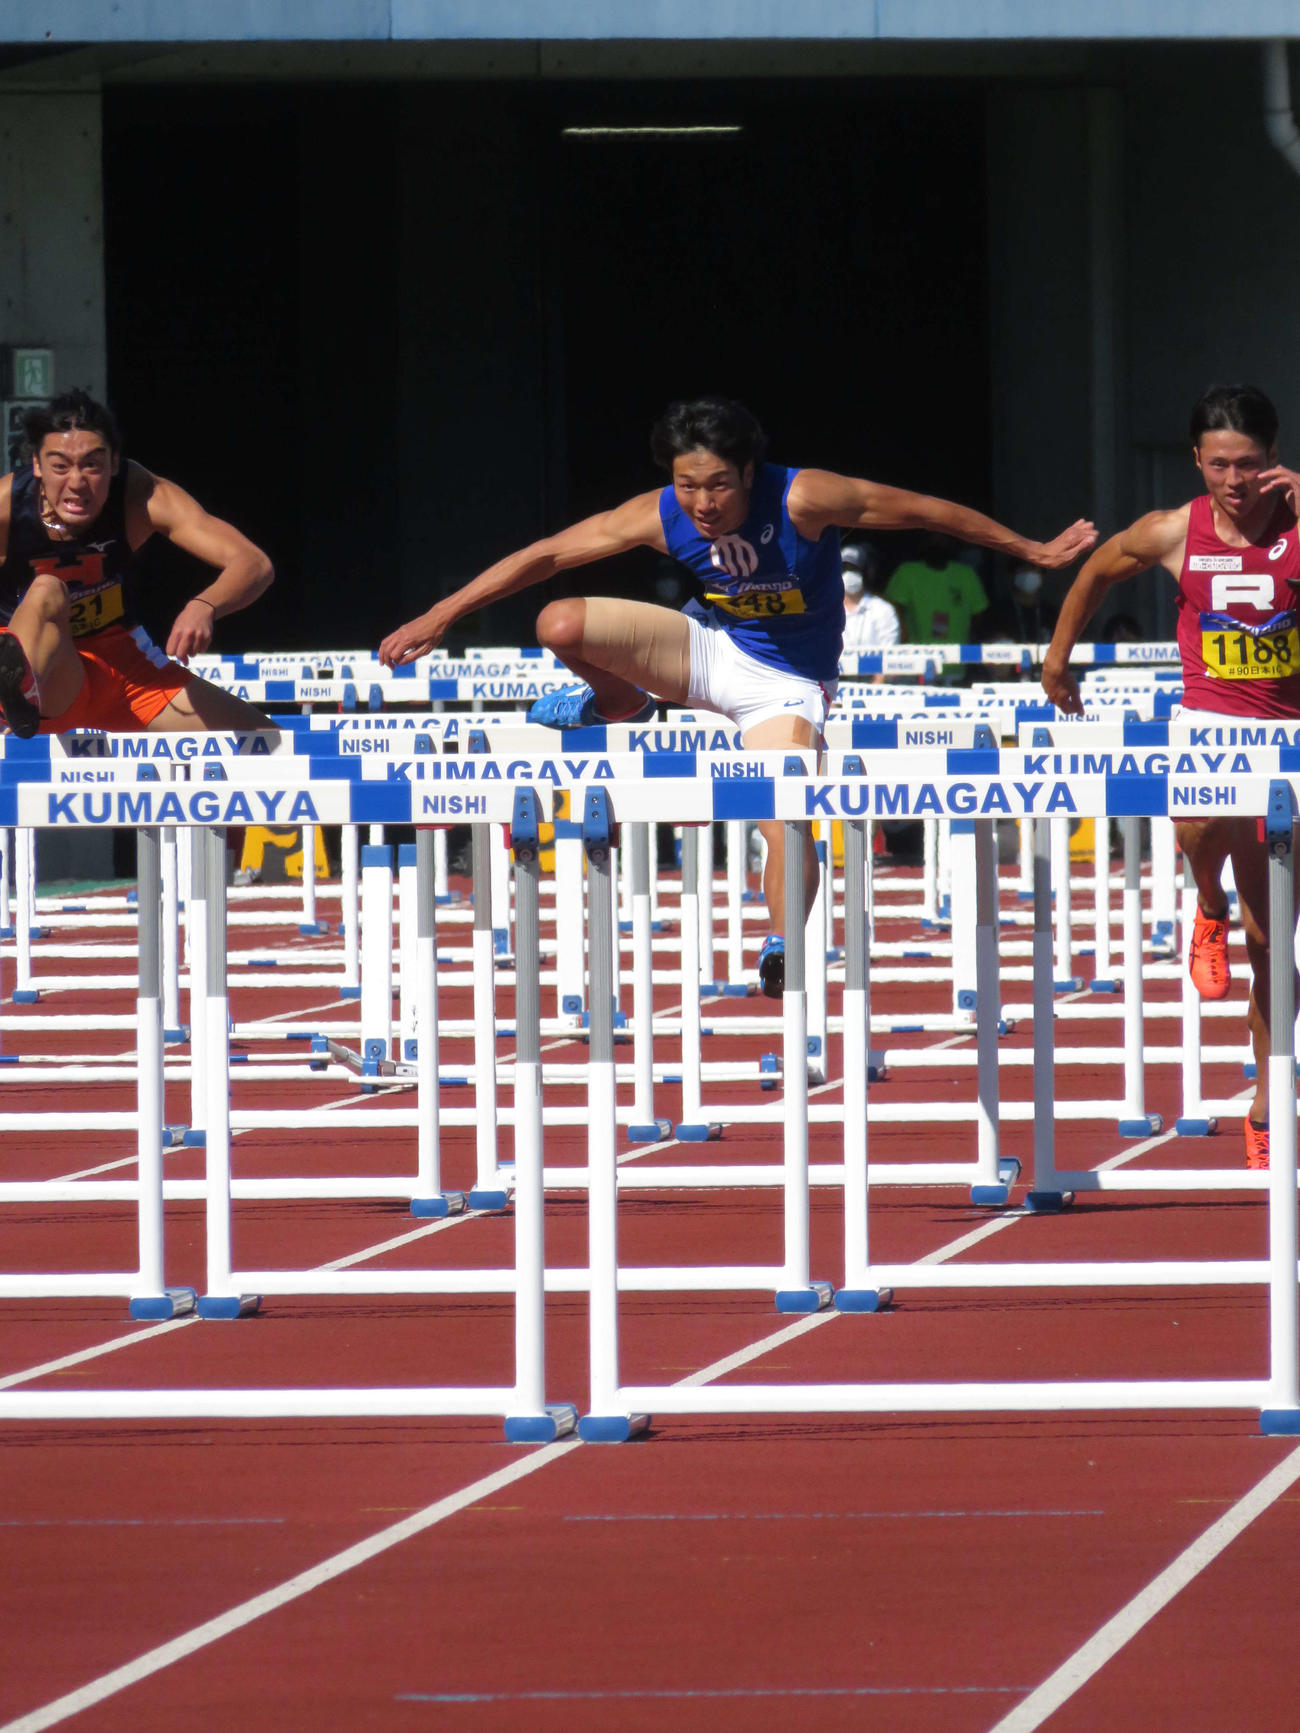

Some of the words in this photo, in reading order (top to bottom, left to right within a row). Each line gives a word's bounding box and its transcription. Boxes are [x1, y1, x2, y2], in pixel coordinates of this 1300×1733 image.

[1211, 574, 1275, 611] R
[1212, 633, 1292, 666] 1188
[300, 688, 331, 697] NISHI
[342, 739, 390, 753] NISHI
[905, 731, 953, 745] NISHI
[1190, 727, 1300, 747] KUMA
[71, 736, 274, 761] KUMAGAYA
[387, 760, 615, 787] KUMAGAYA
[710, 762, 765, 778] NISHI
[1023, 753, 1252, 775] KUMAGAYA
[422, 795, 487, 815] NISHI
[804, 781, 1078, 816] KUMAGAYA
[1172, 785, 1237, 806] NISHI
[47, 790, 320, 824] KUMAGAYA
